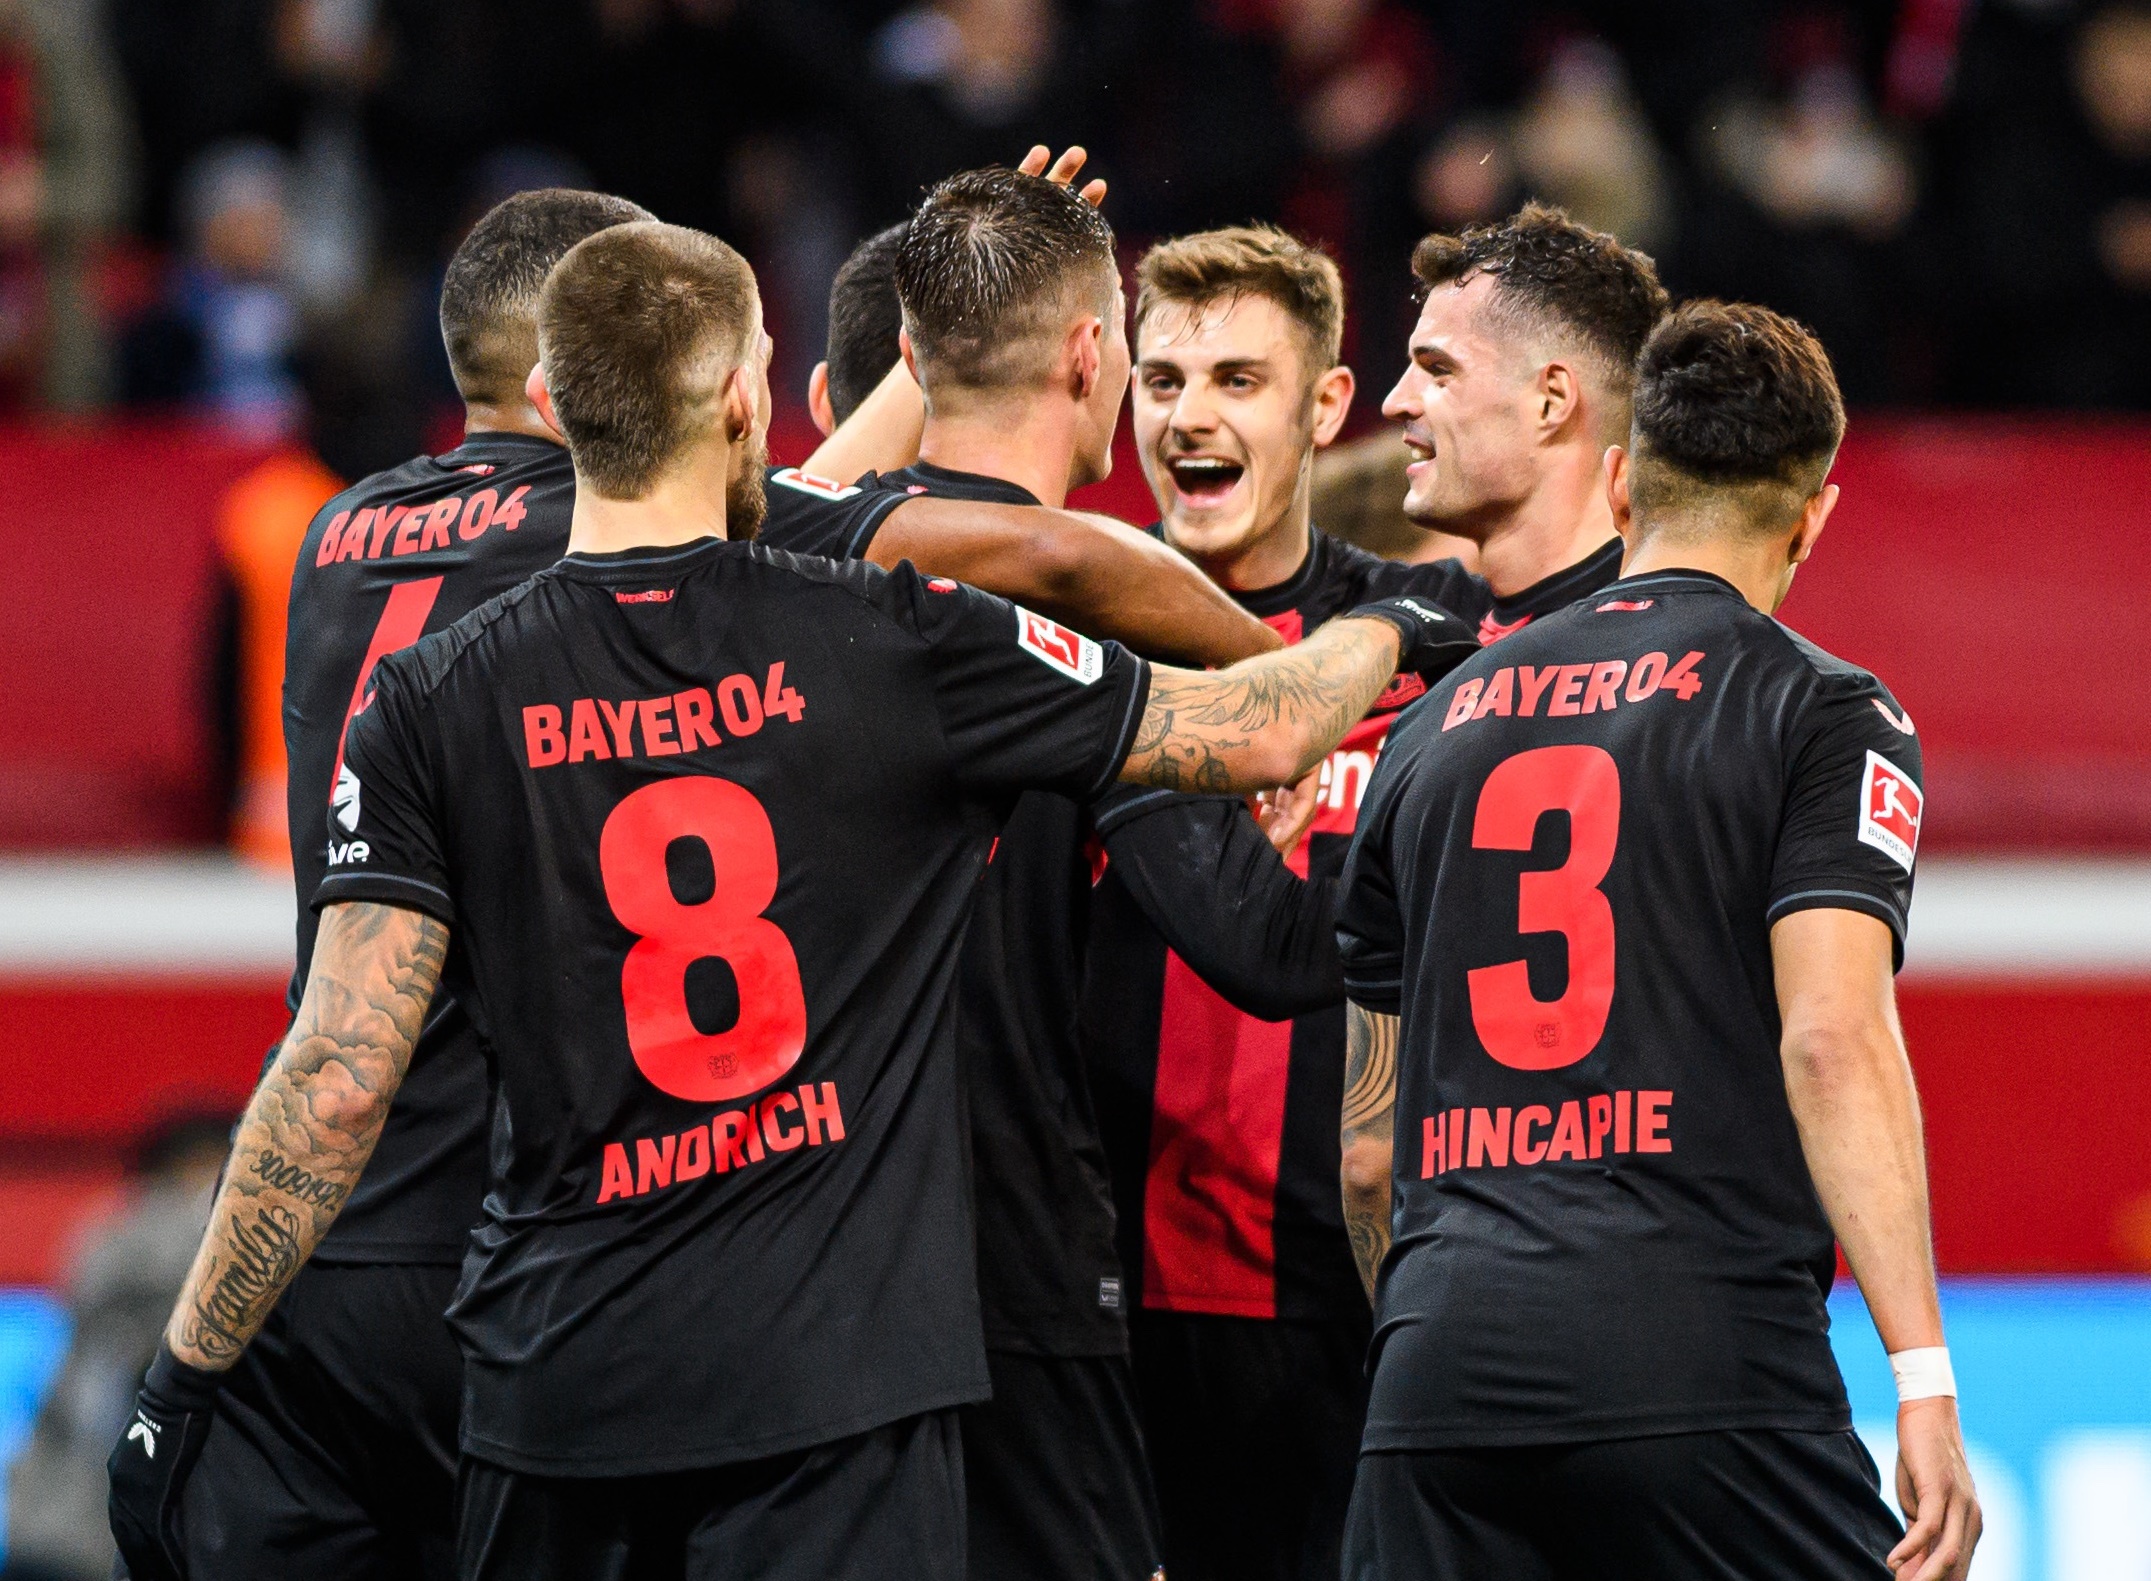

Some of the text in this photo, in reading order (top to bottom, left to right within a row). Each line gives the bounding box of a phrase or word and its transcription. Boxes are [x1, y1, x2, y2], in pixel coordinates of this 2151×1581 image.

[600, 775, 807, 1102] 8
[1467, 744, 1621, 1071] 3
[597, 1081, 846, 1204] ANDRICH
[1421, 1090, 1674, 1180] HINCAPIE
